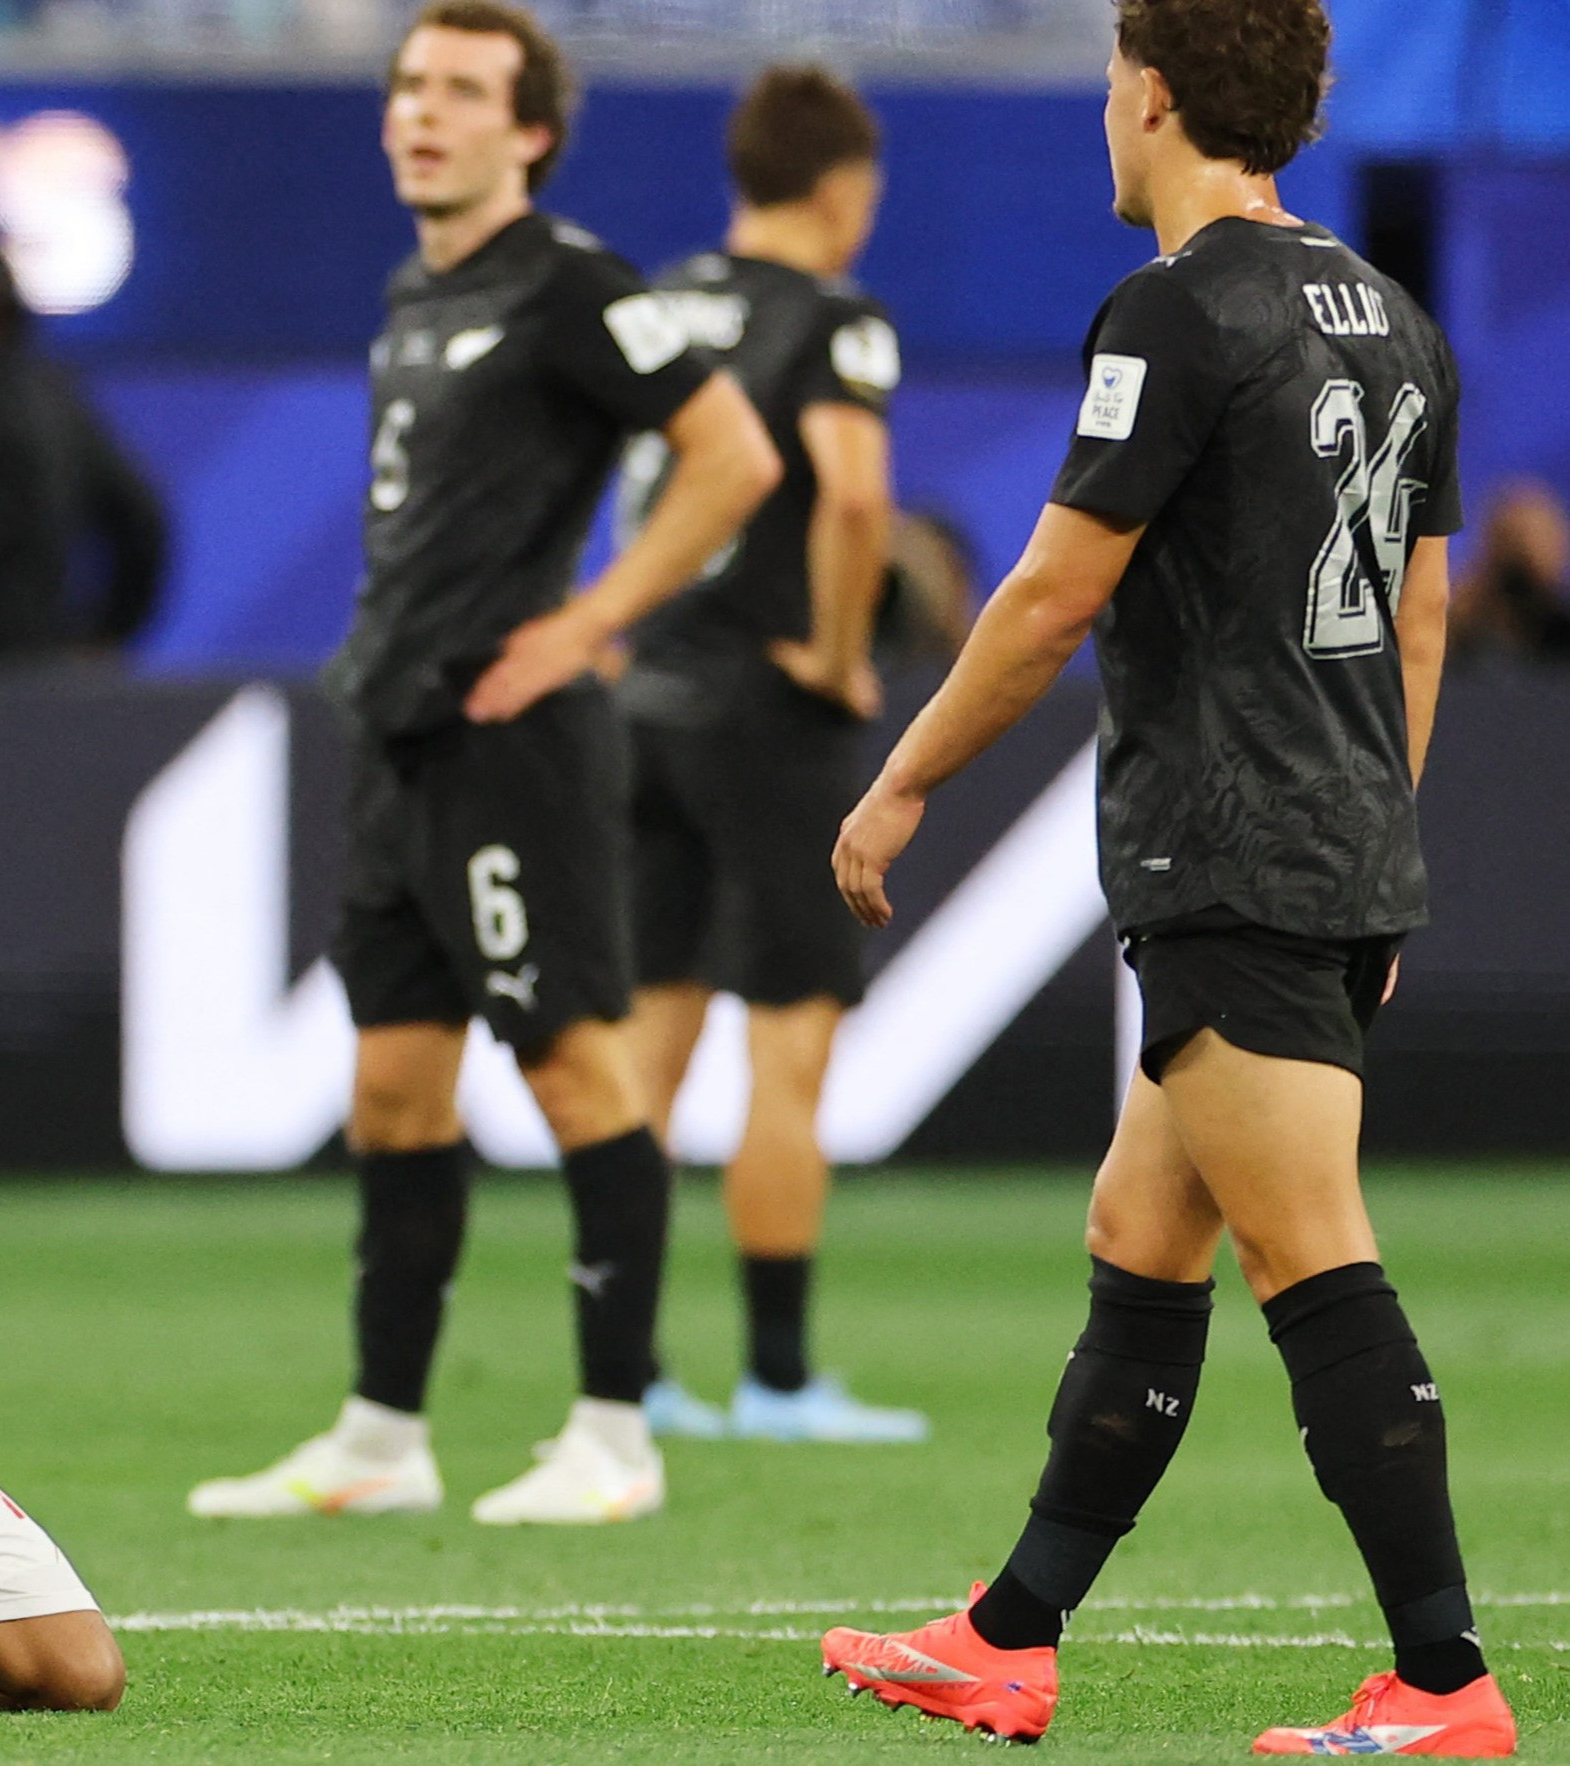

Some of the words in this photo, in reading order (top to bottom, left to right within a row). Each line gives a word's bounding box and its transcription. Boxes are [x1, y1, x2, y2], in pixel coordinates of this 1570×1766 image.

[1304, 379, 1428, 660] 24
[467, 844, 529, 961] 6
[1145, 1388, 1180, 1417] NZ
[1410, 1382, 1439, 1402] NZ
